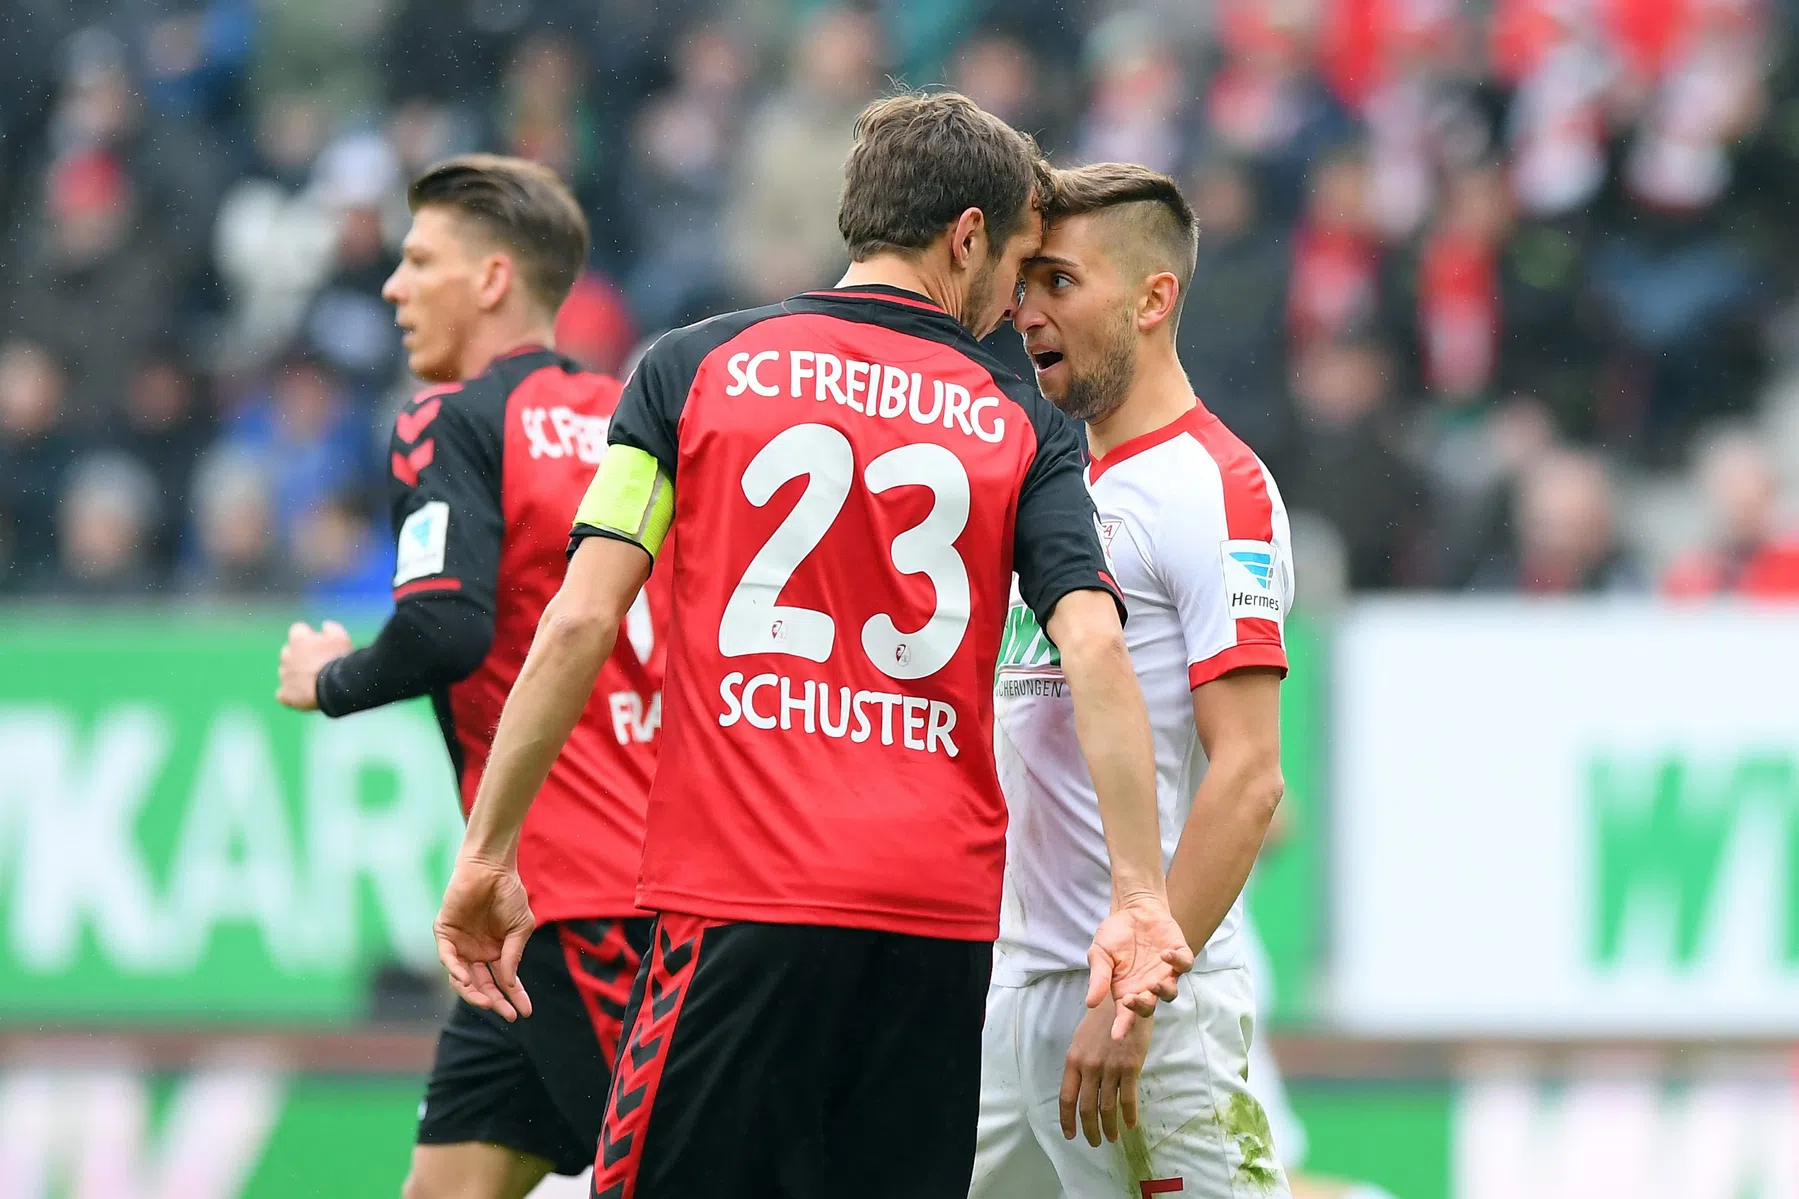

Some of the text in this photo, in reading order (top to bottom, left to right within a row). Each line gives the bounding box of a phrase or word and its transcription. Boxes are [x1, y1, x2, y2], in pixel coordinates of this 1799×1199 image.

[726, 350, 1005, 443] SC FREIBURG
[718, 422, 971, 680] 23
[1231, 591, 1280, 611] Hermes
[718, 671, 960, 758] SCHUSTER
[0, 698, 470, 978] KAR
